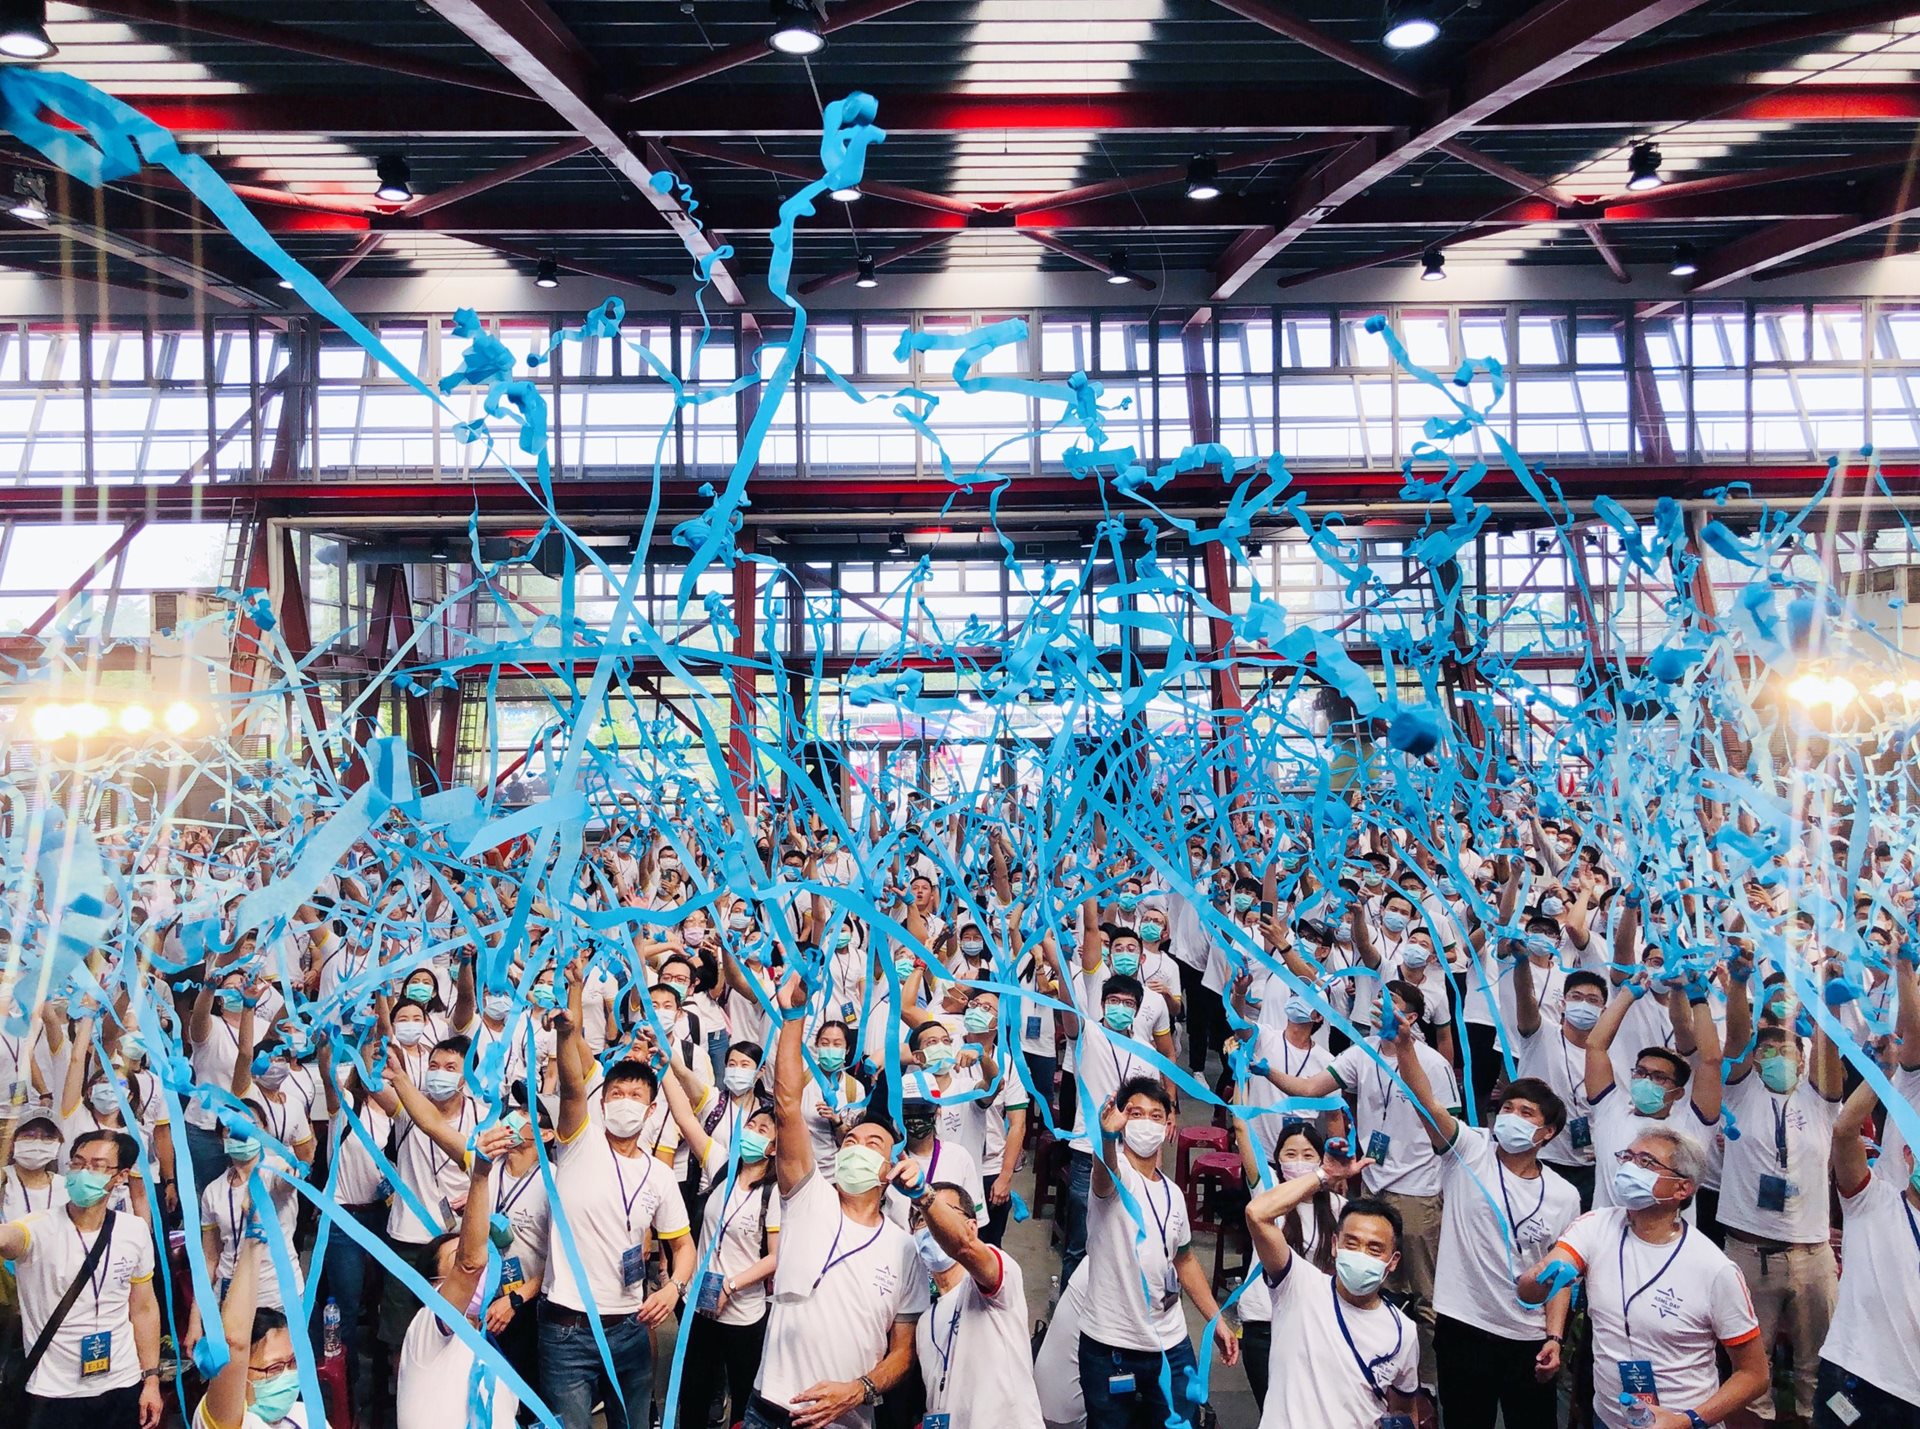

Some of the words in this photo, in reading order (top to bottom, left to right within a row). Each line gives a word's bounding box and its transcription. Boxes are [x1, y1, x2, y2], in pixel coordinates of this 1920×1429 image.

[1654, 1296, 1668, 1305] ASML
[1669, 1301, 1681, 1309] DAY
[88, 1361, 105, 1371] E-12
